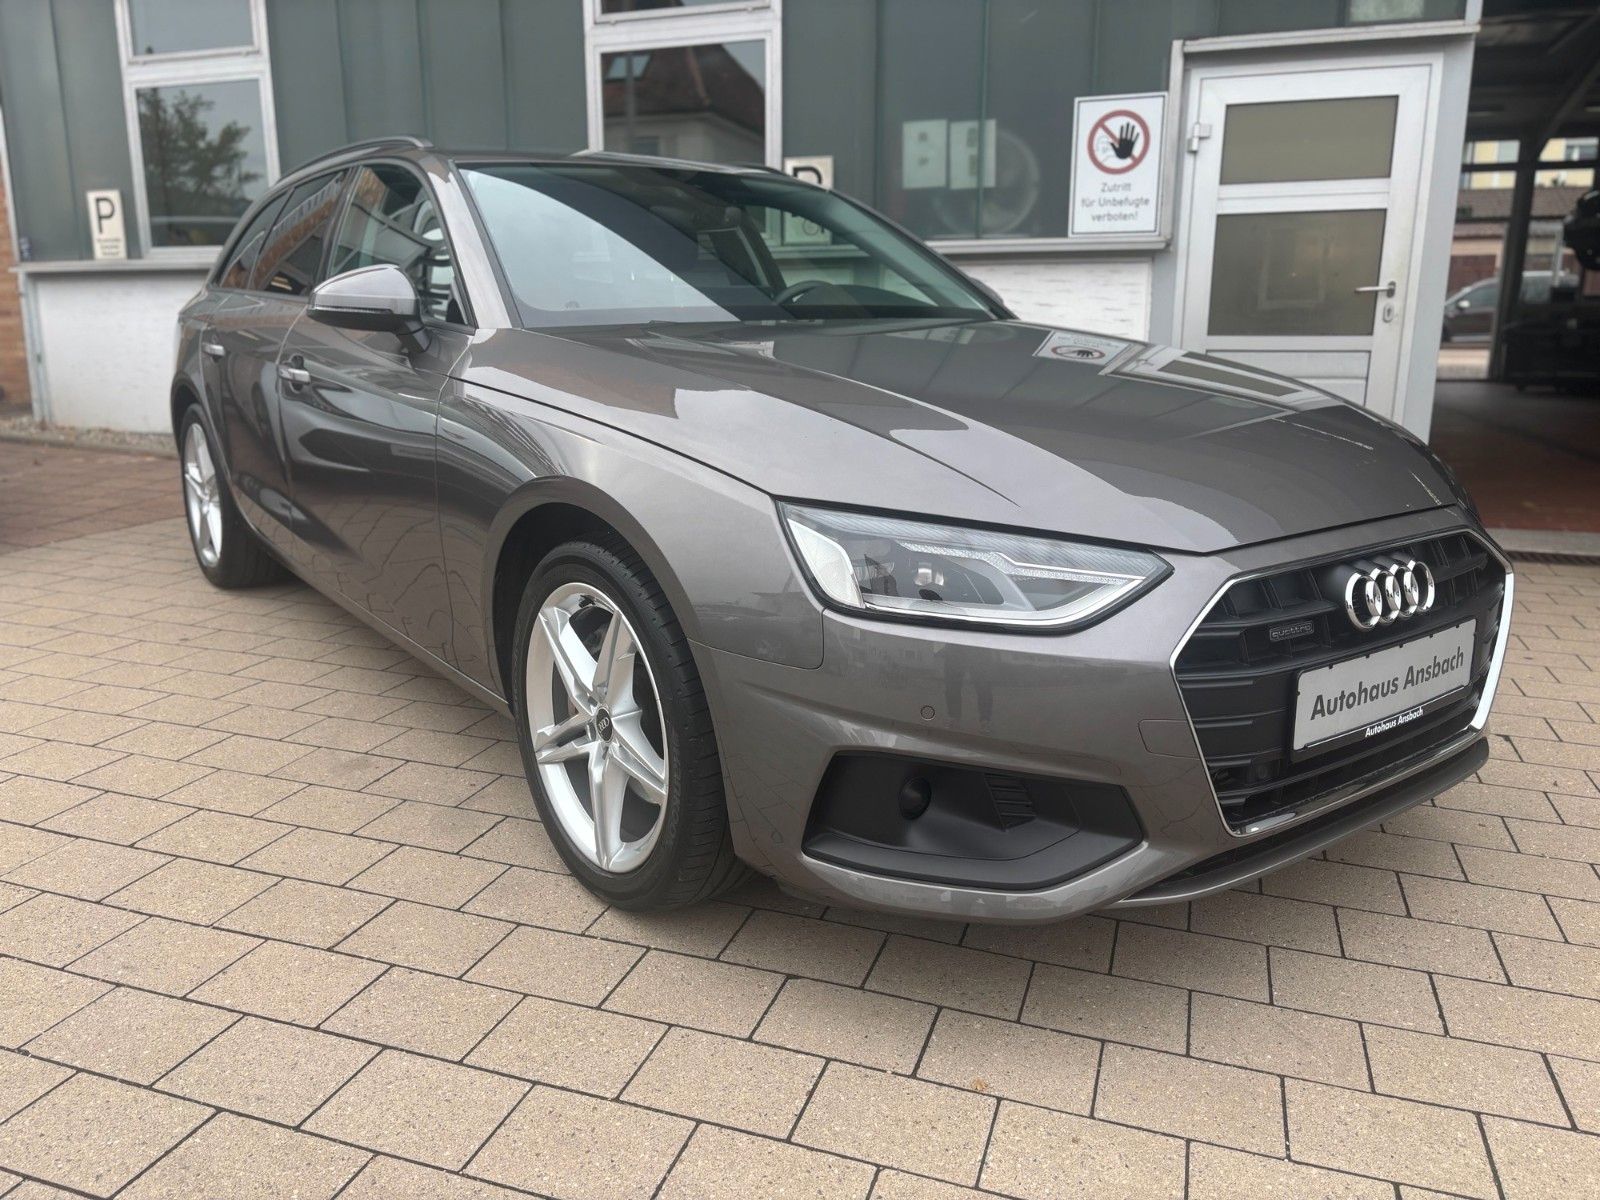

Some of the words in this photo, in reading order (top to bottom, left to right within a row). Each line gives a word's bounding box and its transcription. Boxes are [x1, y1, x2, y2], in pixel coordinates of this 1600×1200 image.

[1101, 182, 1132, 193] Zutritt
[1098, 197, 1150, 209] Unbefugte
[95, 197, 115, 235] P
[1091, 211, 1138, 222] verboten!
[1310, 680, 1399, 720] Autohaus
[1402, 646, 1464, 690] Ansbach
[1364, 721, 1397, 738] Autohaus
[1397, 706, 1424, 725] Ansbach
